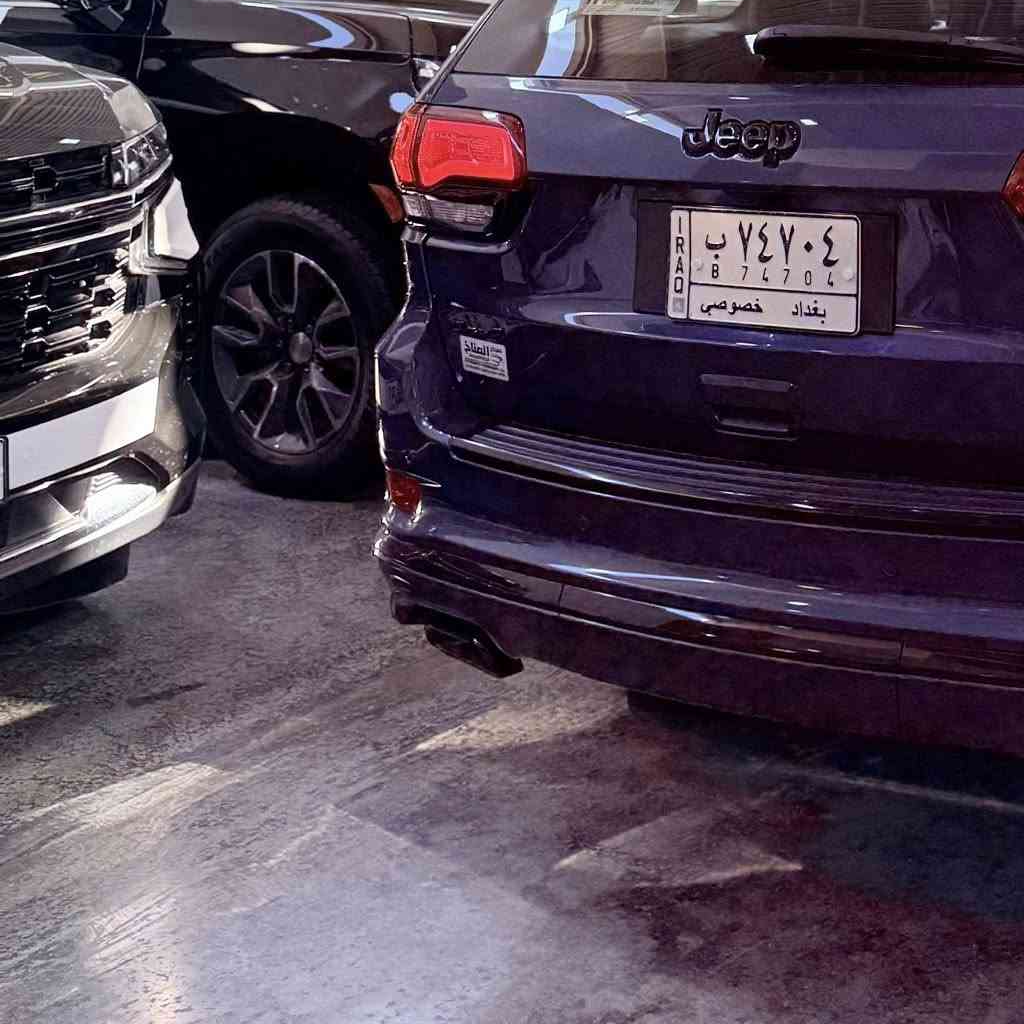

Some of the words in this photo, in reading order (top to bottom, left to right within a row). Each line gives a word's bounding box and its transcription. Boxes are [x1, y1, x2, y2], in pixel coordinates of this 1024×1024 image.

[682, 107, 801, 168] Jeep
[673, 216, 685, 295] IRAQ
[700, 297, 764, 316] خصوصي
[791, 299, 828, 325] بغداد
